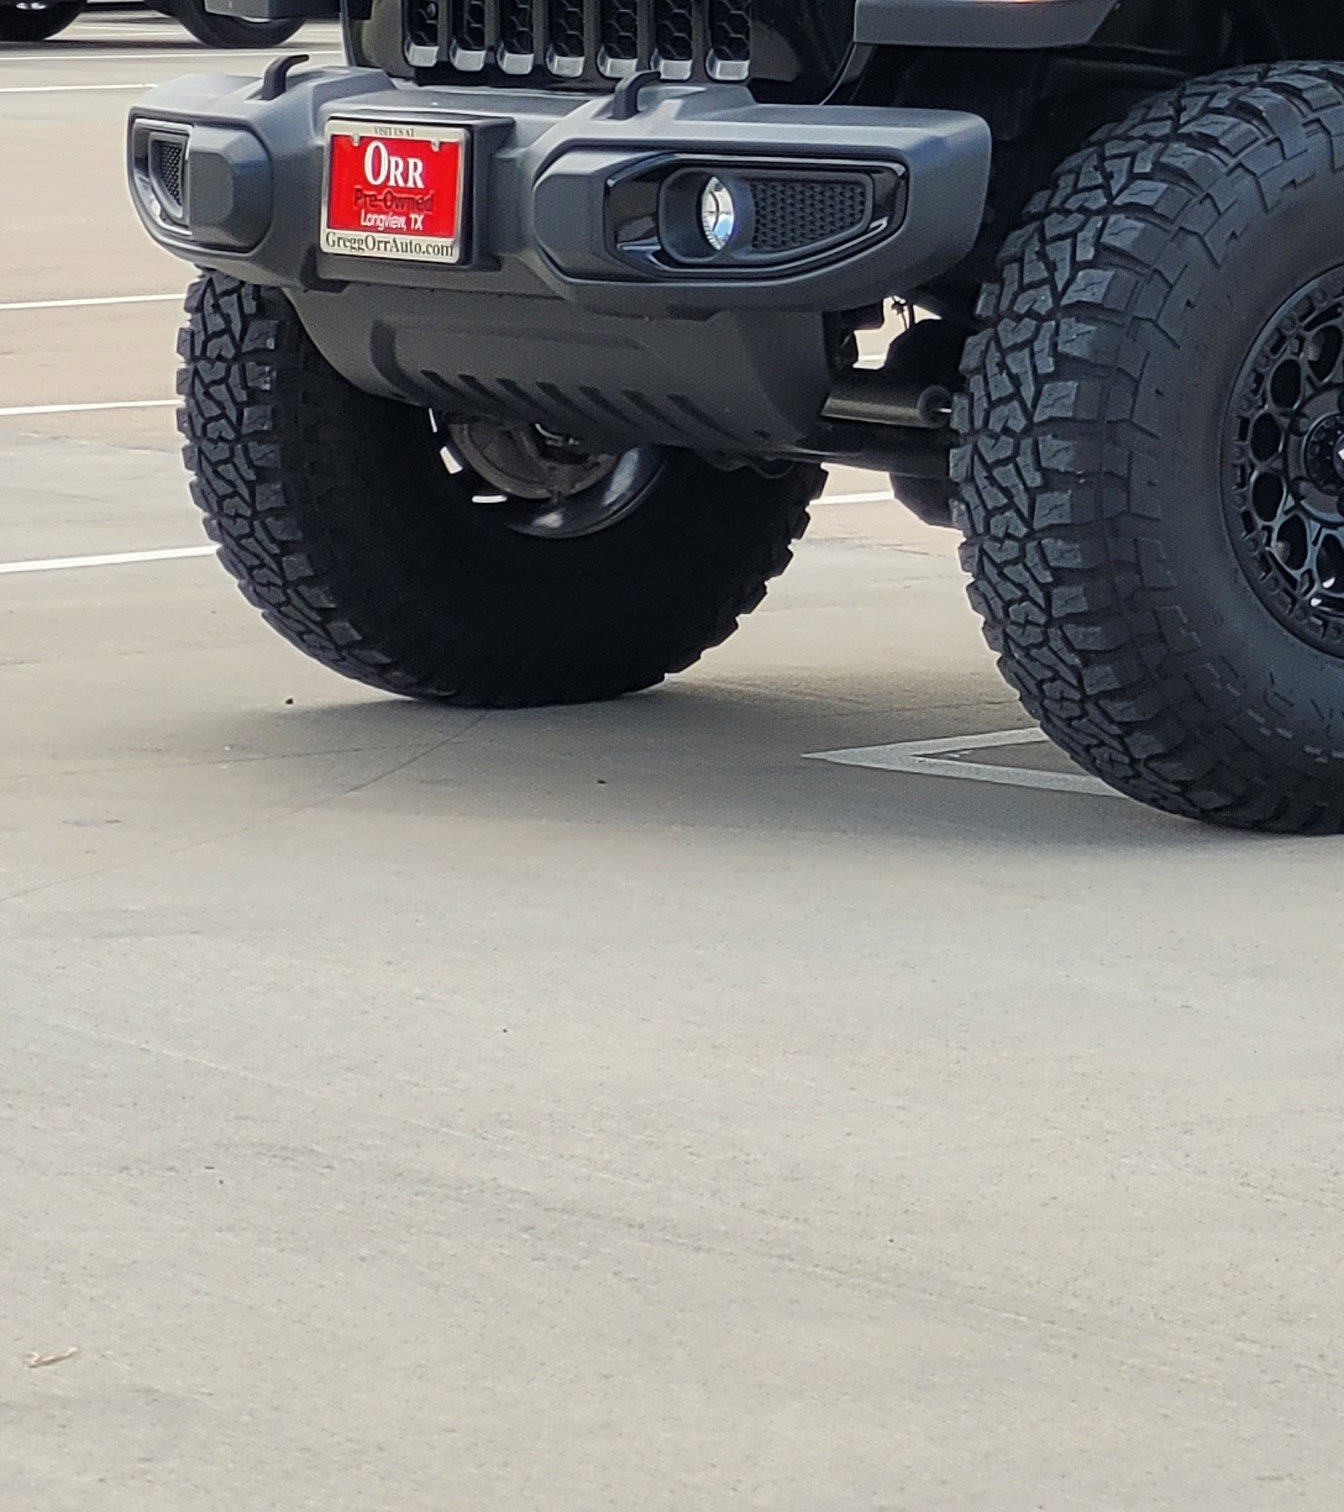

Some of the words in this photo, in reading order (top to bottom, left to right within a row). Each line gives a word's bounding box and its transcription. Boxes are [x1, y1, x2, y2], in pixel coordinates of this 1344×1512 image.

[354, 188, 434, 211] Pre-Owned
[409, 213, 425, 230] TX
[325, 231, 455, 257] GreggOrrAuto.com
